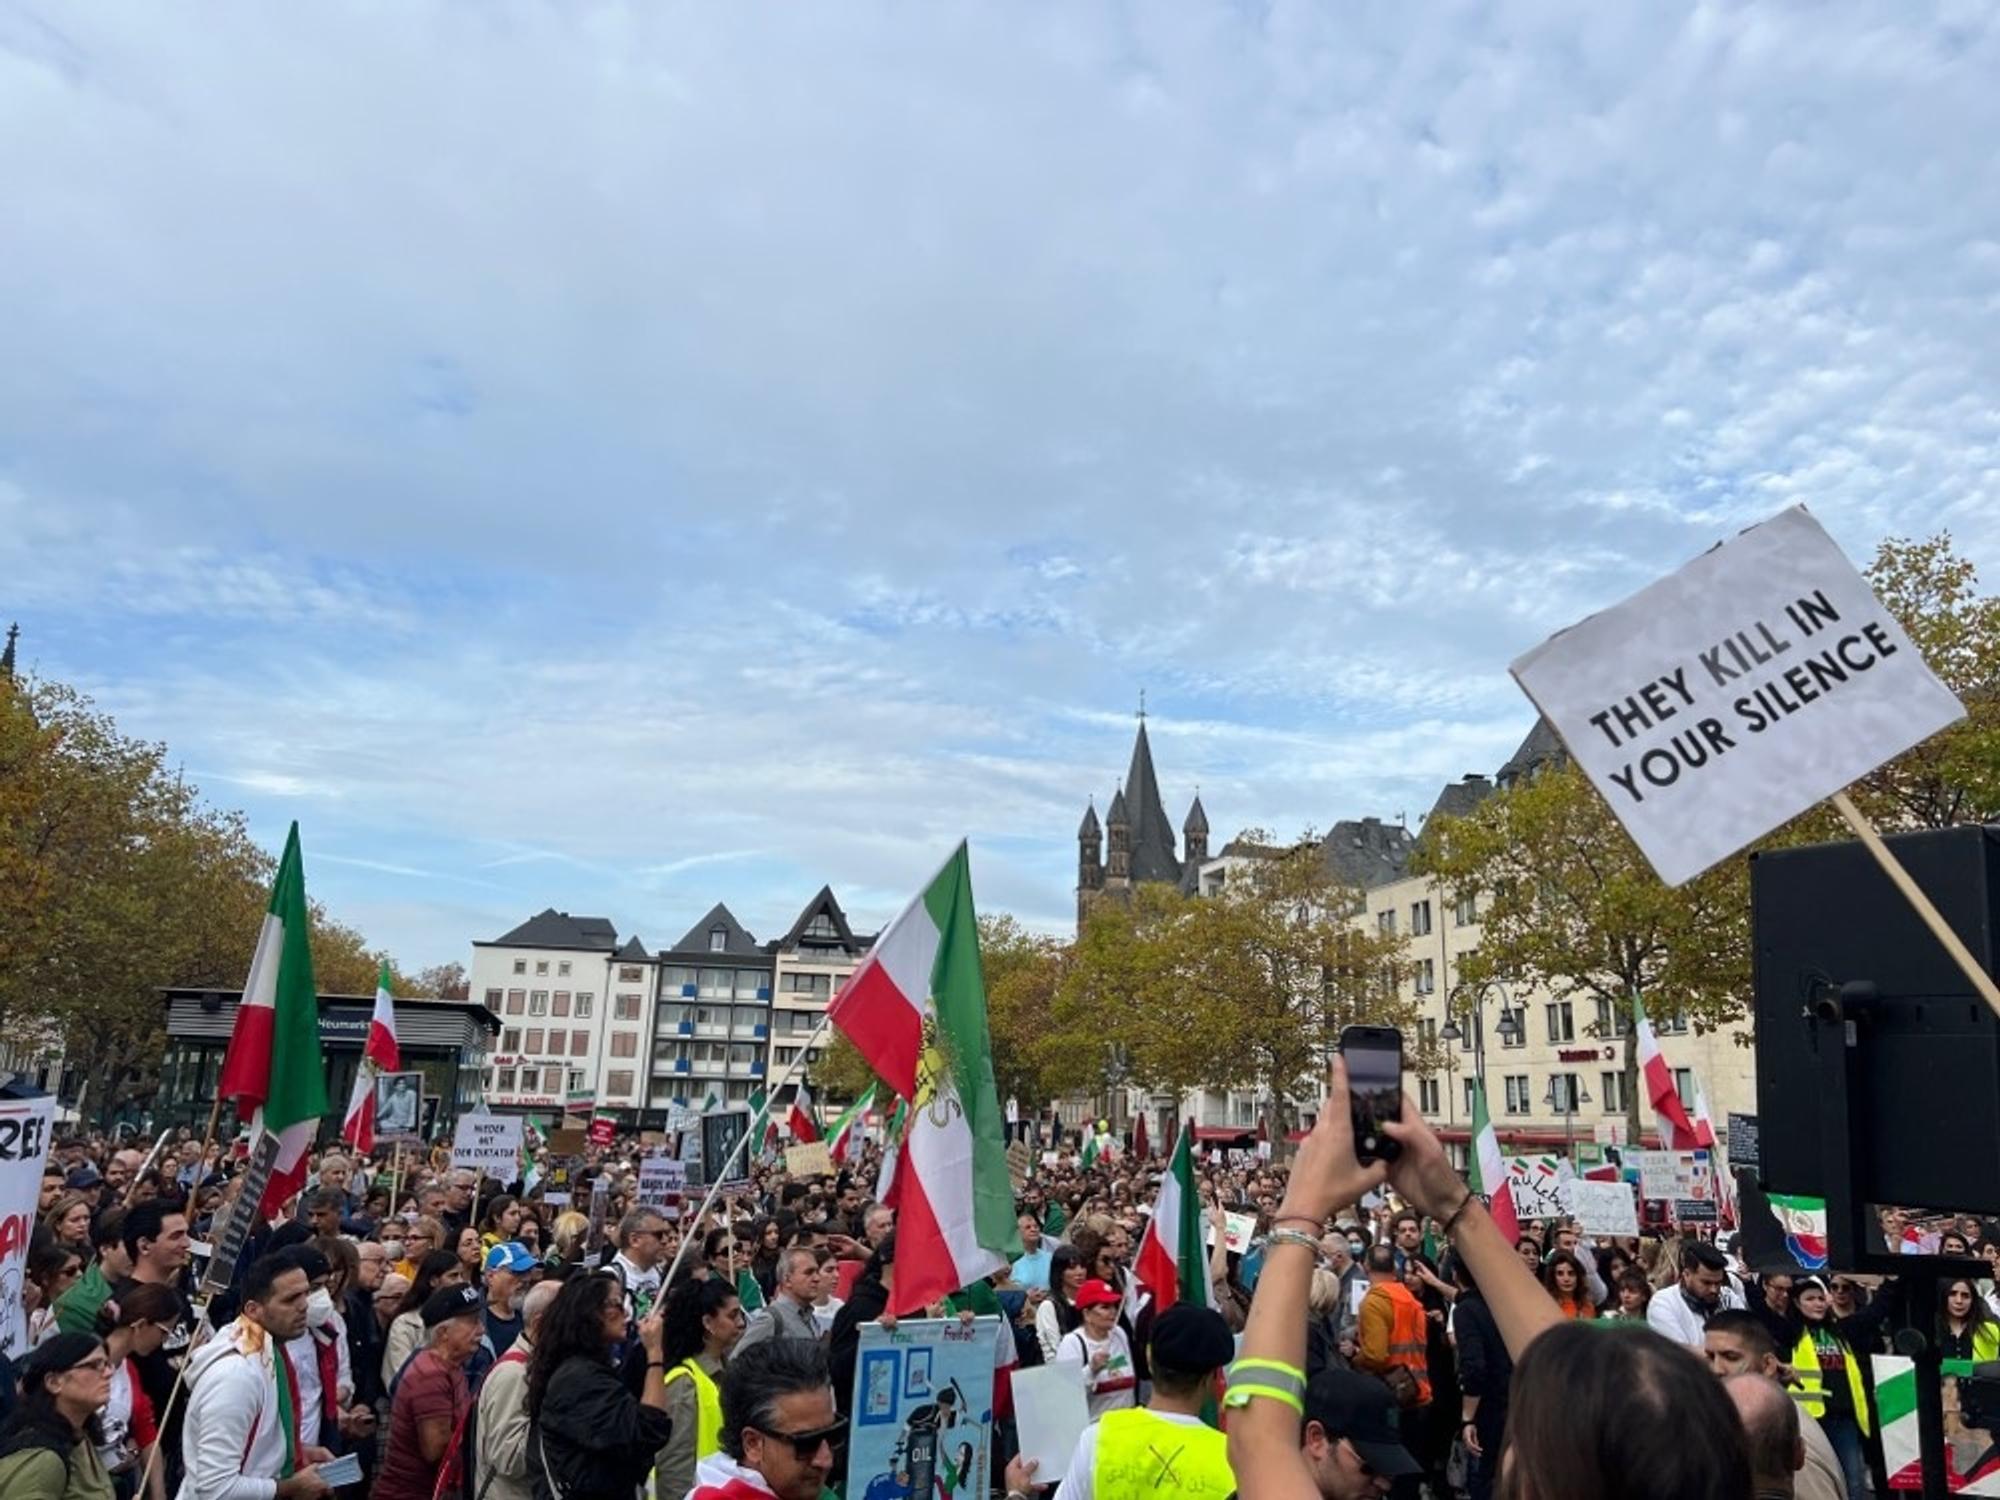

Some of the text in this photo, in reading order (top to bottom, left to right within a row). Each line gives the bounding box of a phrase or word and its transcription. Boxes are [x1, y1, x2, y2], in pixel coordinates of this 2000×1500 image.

[1589, 589, 1841, 747] THEY KILL IN
[1608, 622, 1898, 803] YOUR SILENCE
[911, 1447, 932, 1463] OIL
